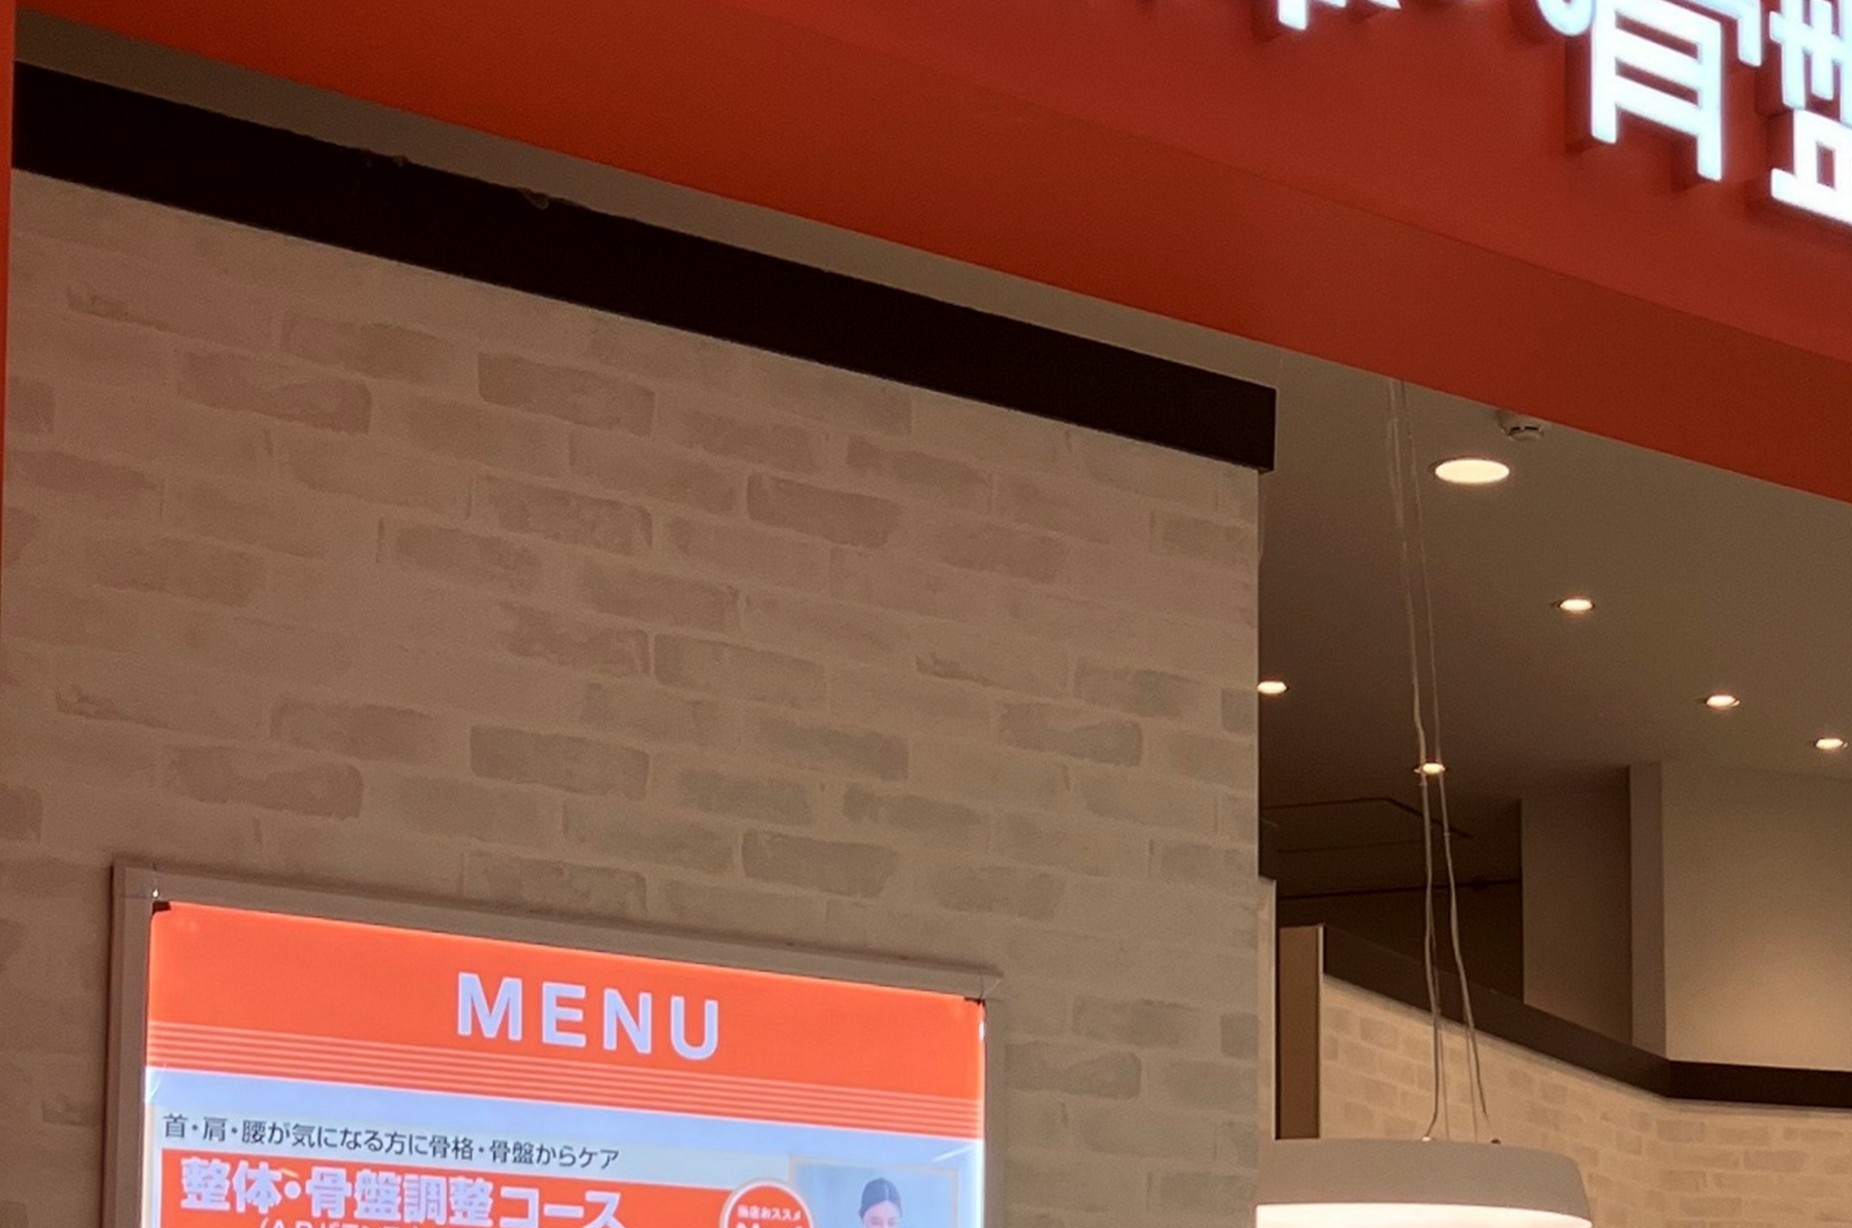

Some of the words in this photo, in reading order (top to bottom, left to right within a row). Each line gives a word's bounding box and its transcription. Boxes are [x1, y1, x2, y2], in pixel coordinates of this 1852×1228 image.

[457, 971, 720, 1060] MENU
[163, 1113, 620, 1170] 首・肩・腰が気になる方に骨格・骨盤からケア
